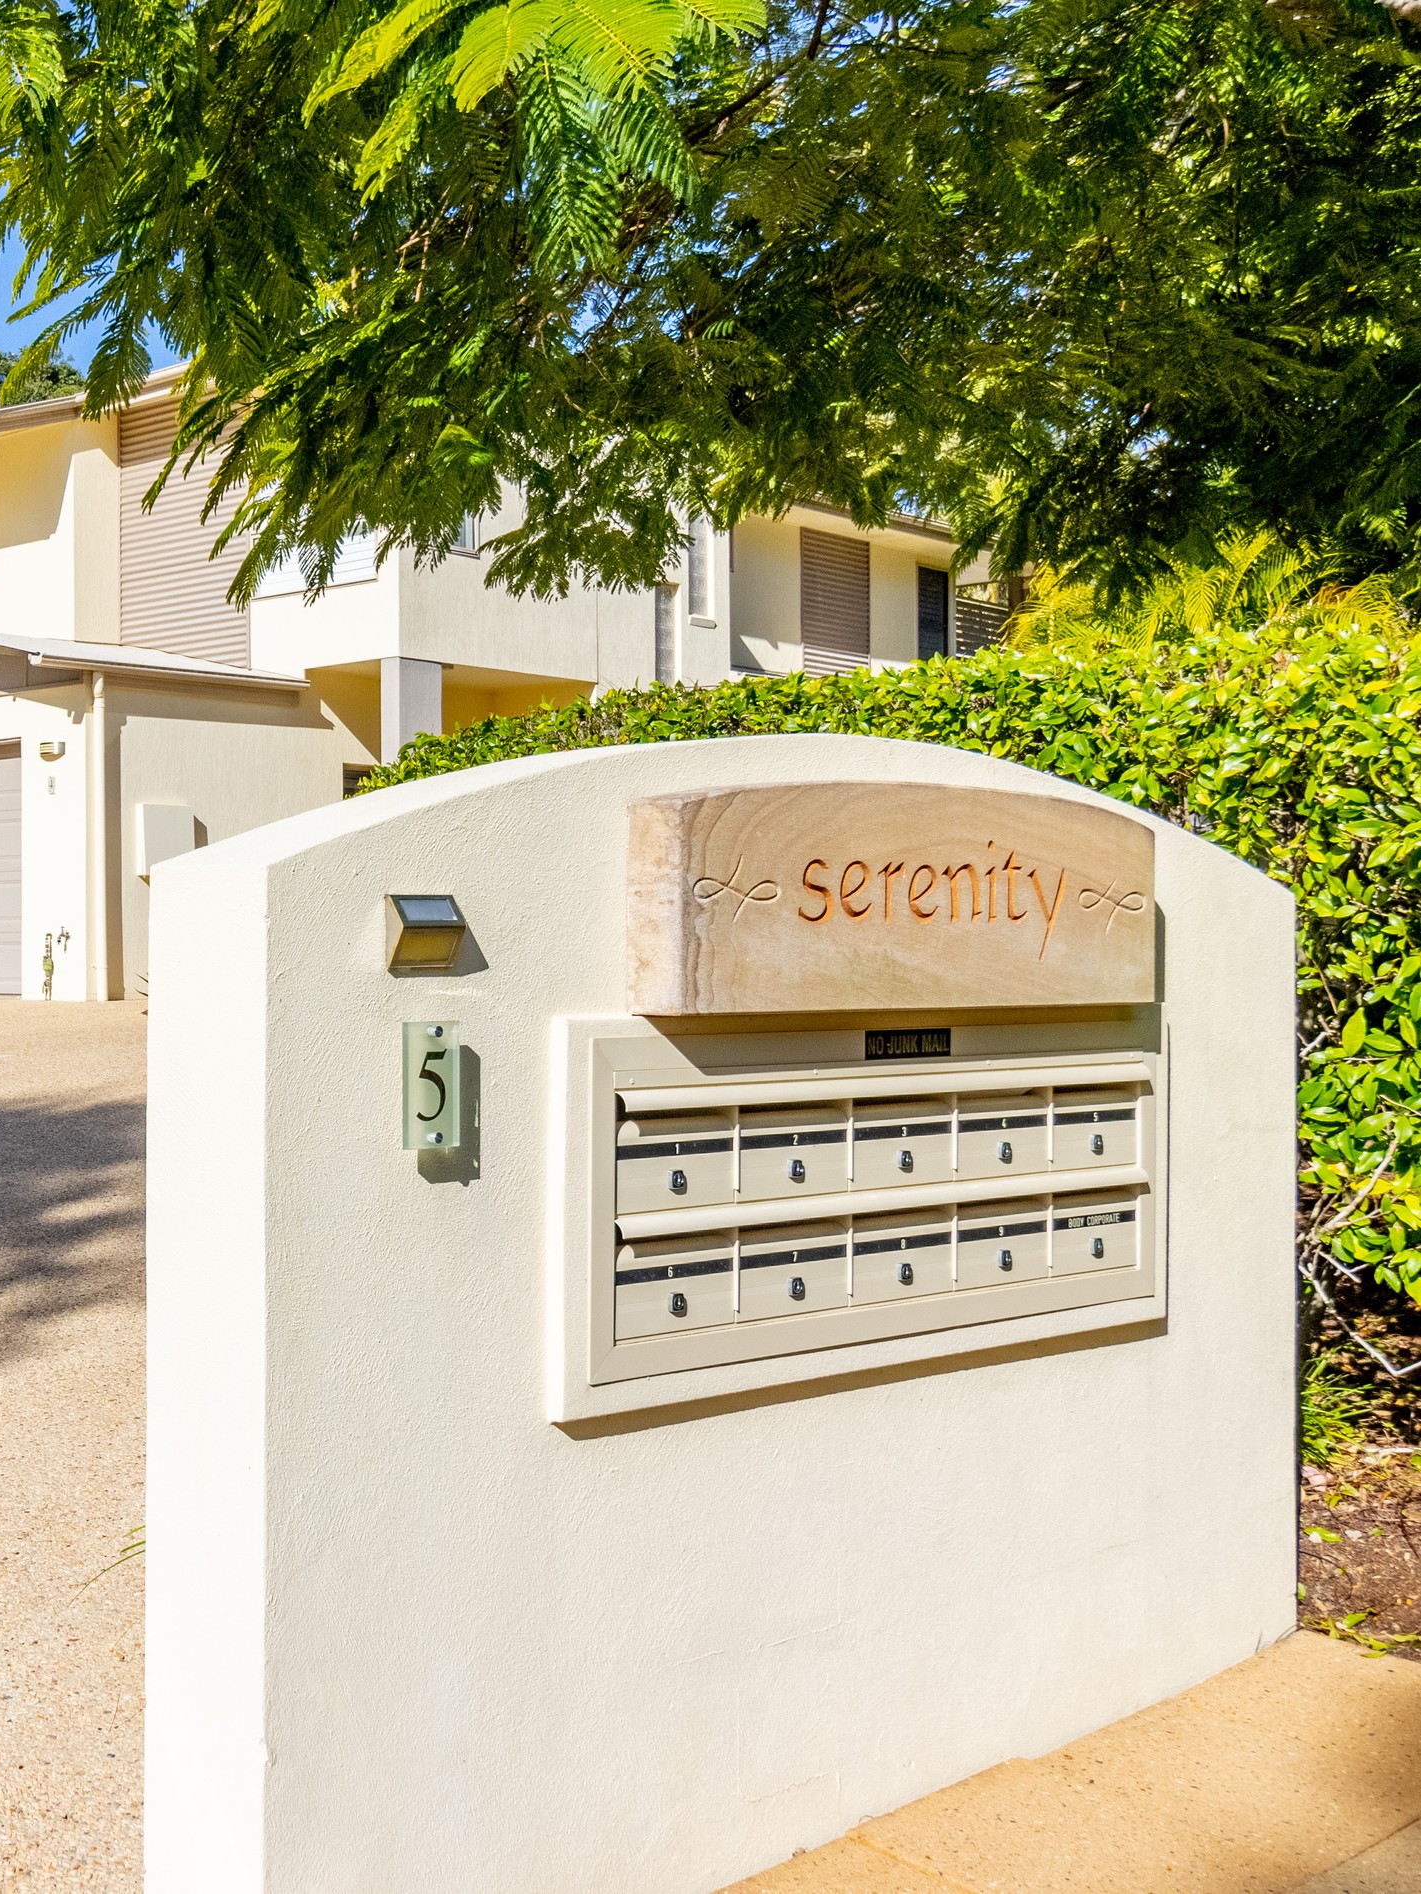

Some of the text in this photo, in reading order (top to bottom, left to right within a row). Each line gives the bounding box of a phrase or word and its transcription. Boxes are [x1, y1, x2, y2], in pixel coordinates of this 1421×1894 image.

[797, 839, 1067, 962] serenity
[867, 1033, 950, 1055] NO JUNK MAIL
[416, 1048, 448, 1122] 5
[1093, 1111, 1098, 1122] 5
[1001, 1118, 1007, 1128] 4
[901, 1126, 907, 1137] 3
[792, 1134, 798, 1145] 2
[675, 1143, 679, 1155] 1
[1067, 1212, 1120, 1228] BODY CORPORATE
[998, 1226, 1004, 1236] 9
[900, 1238, 906, 1249] 8
[792, 1251, 798, 1262] 7
[667, 1266, 673, 1278] 6
